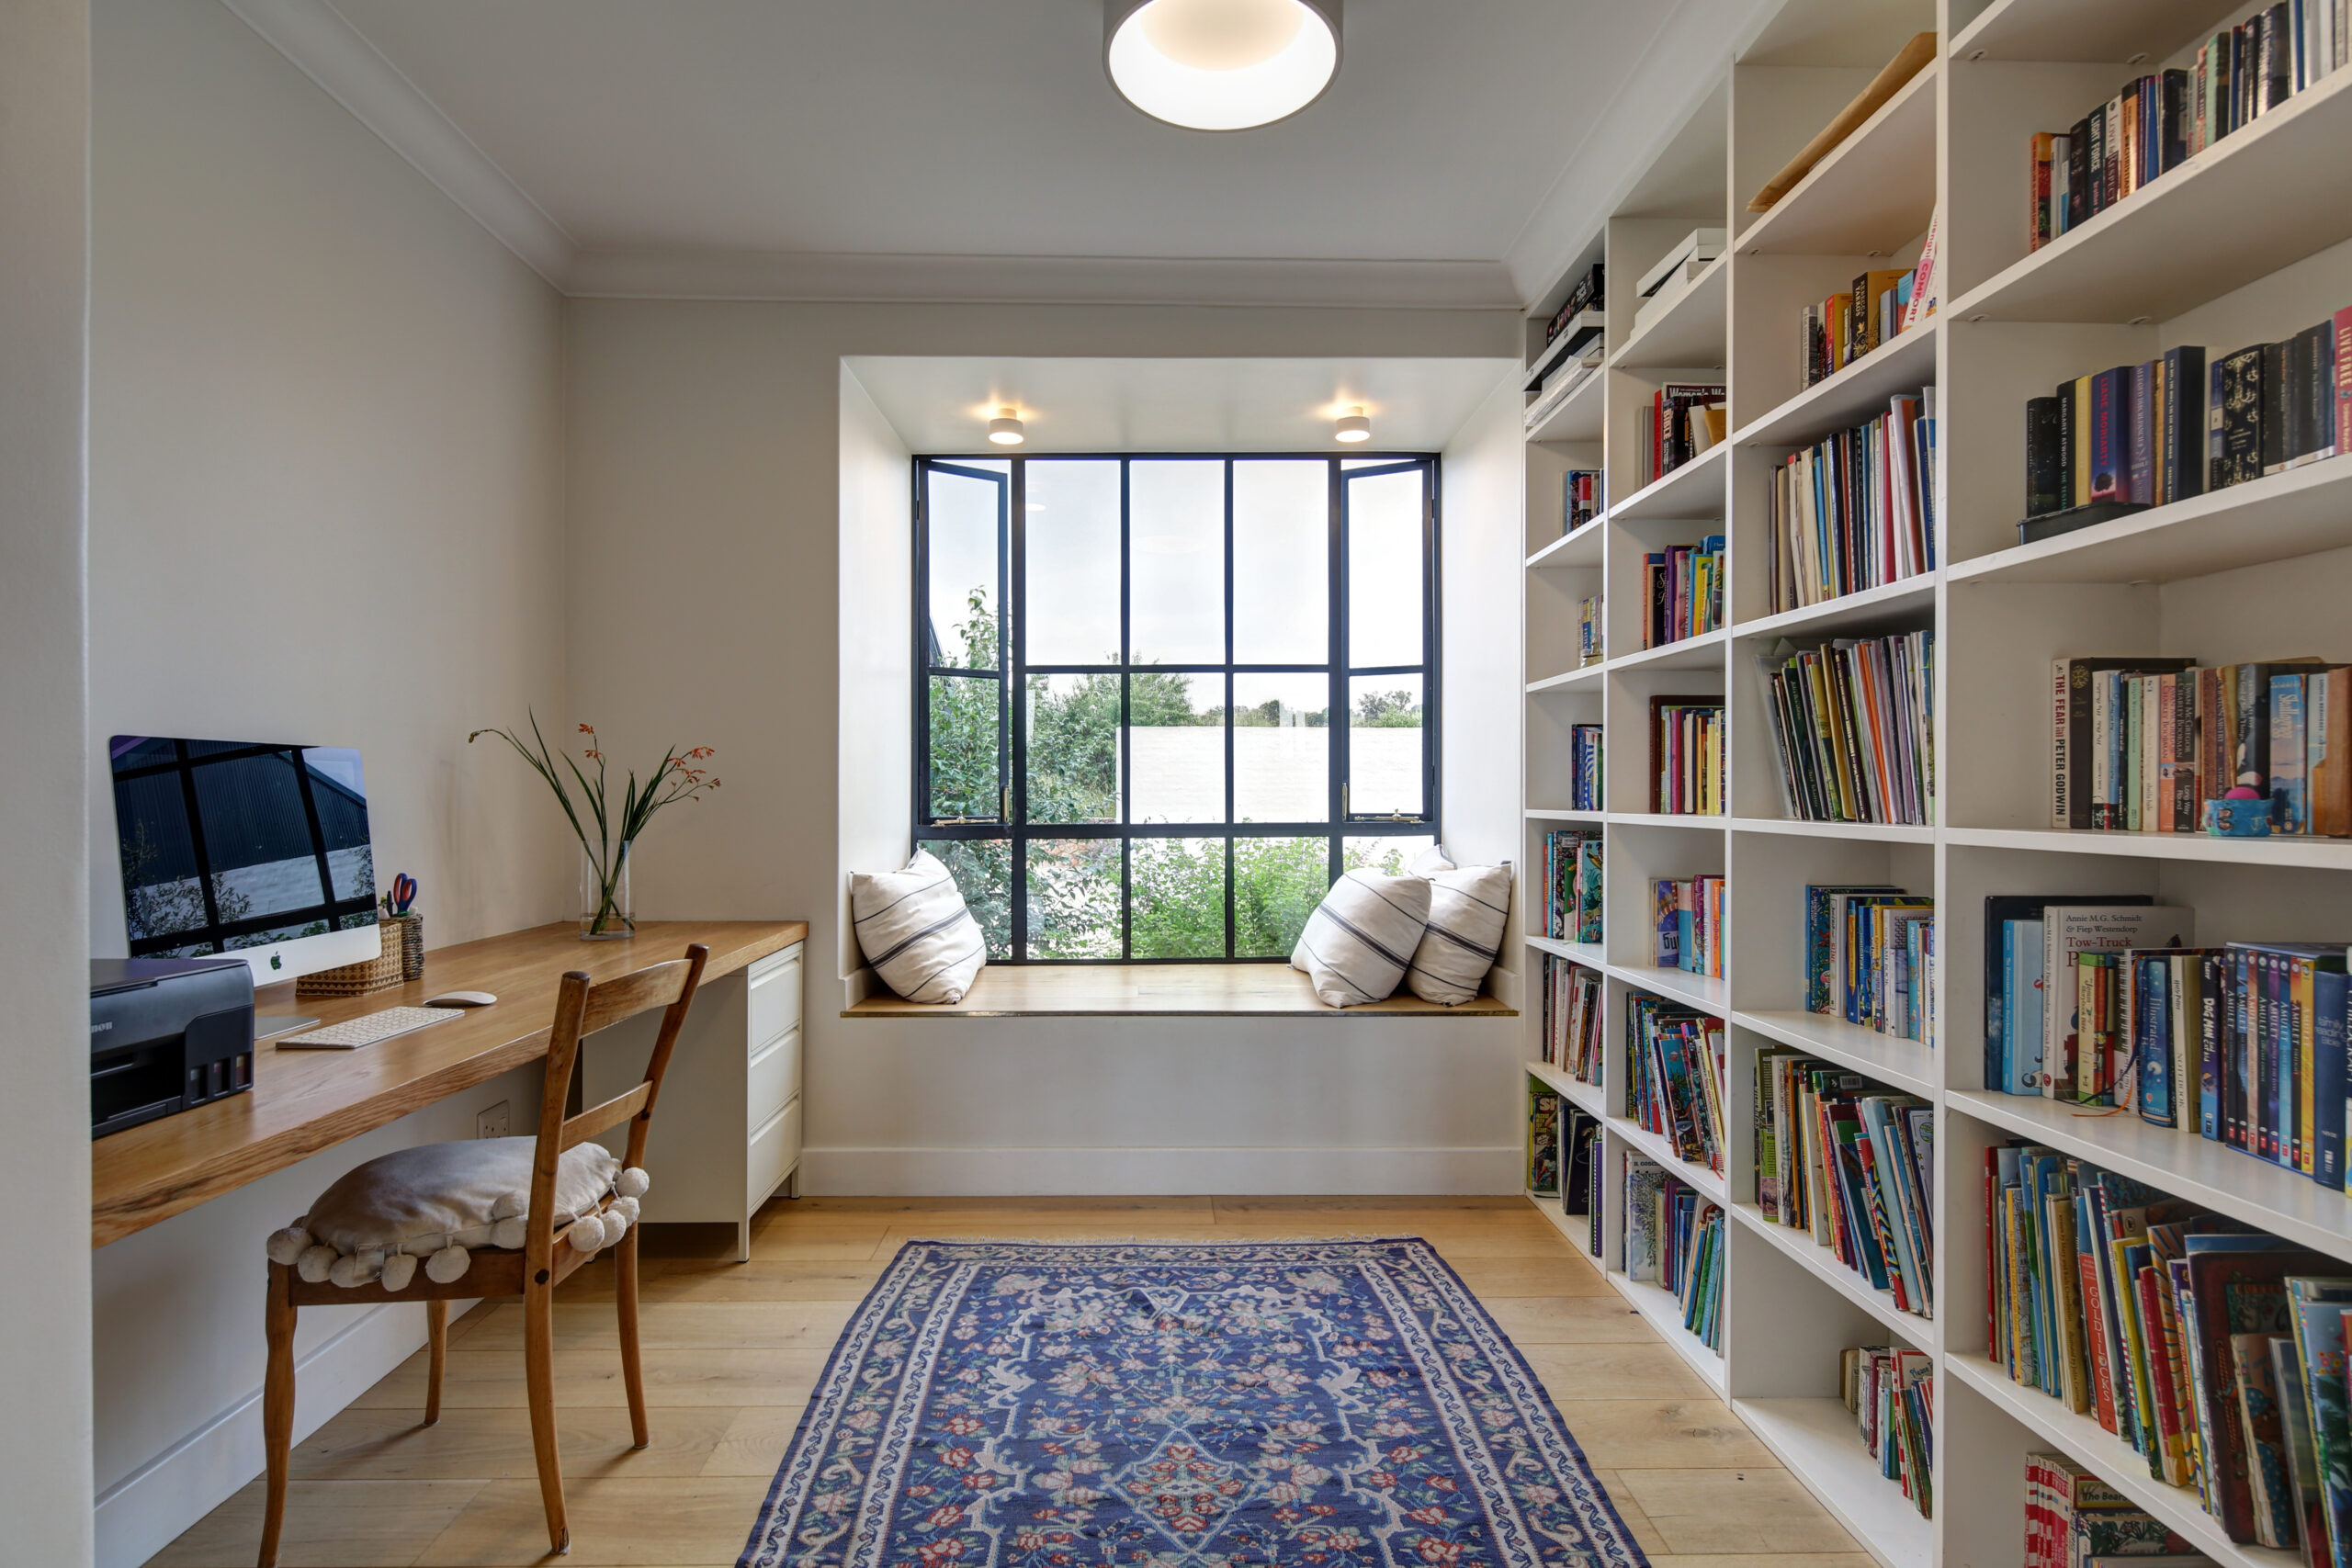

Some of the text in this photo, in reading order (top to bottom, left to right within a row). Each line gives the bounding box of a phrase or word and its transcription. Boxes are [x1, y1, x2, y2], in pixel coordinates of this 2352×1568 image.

[2090, 114, 2101, 173] LIGHT FORCE
[2108, 115, 2119, 145] LOVE
[2107, 153, 2117, 203] RESPECT
[1908, 263, 1929, 323] COMFORT
[2339, 326, 2351, 387] LIVE FREE
[1663, 408, 1672, 440] BIBLE
[2099, 377, 2109, 467] LIANE MORIARTY
[2055, 674, 2066, 697] THE
[2055, 699, 2066, 725] FEAR
[2176, 682, 2184, 758] CHARLEY BOORMAN
[2273, 694, 2299, 739] Skallagrigg
[2055, 739, 2066, 770] PETER
[2055, 773, 2066, 816] GODWIN
[2176, 790, 2184, 810] Round
[2183, 784, 2191, 800] Long
[2065, 937, 2132, 947] Tow-Truck
[2149, 998, 2162, 1051] Illustrated
[2203, 998, 2215, 1039] DOG MAN
[2227, 990, 2235, 1029] AMULET
[2238, 992, 2246, 1031] AMULET
[2258, 996, 2267, 1035] AMULET
[2280, 1001, 2289, 1041] AMULET
[2291, 1004, 2300, 1045] AMULET
[2177, 1053, 2186, 1108] NOTEBOOK
[2088, 1285, 2111, 1402] GOLDILOCKS
[2082, 1492, 2100, 1501] The
